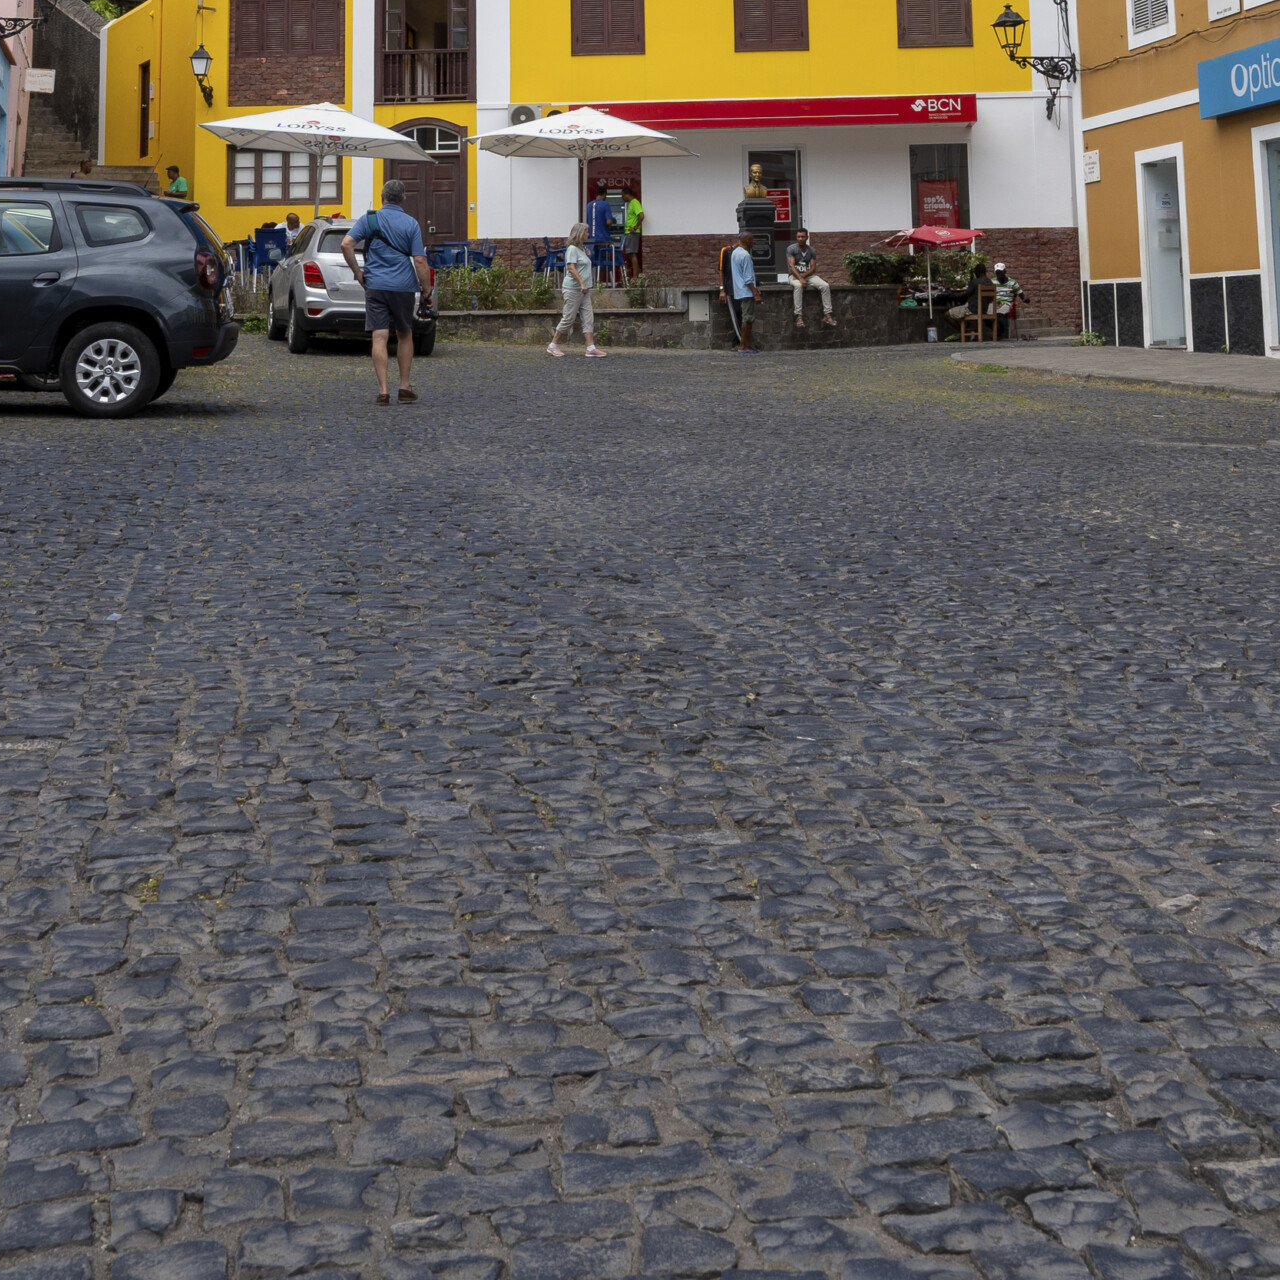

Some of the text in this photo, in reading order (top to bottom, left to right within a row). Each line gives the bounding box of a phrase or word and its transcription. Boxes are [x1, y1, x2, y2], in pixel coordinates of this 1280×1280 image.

[927, 98, 962, 111] BCN
[277, 122, 346, 133] LODYSS
[607, 177, 631, 187] BCN
